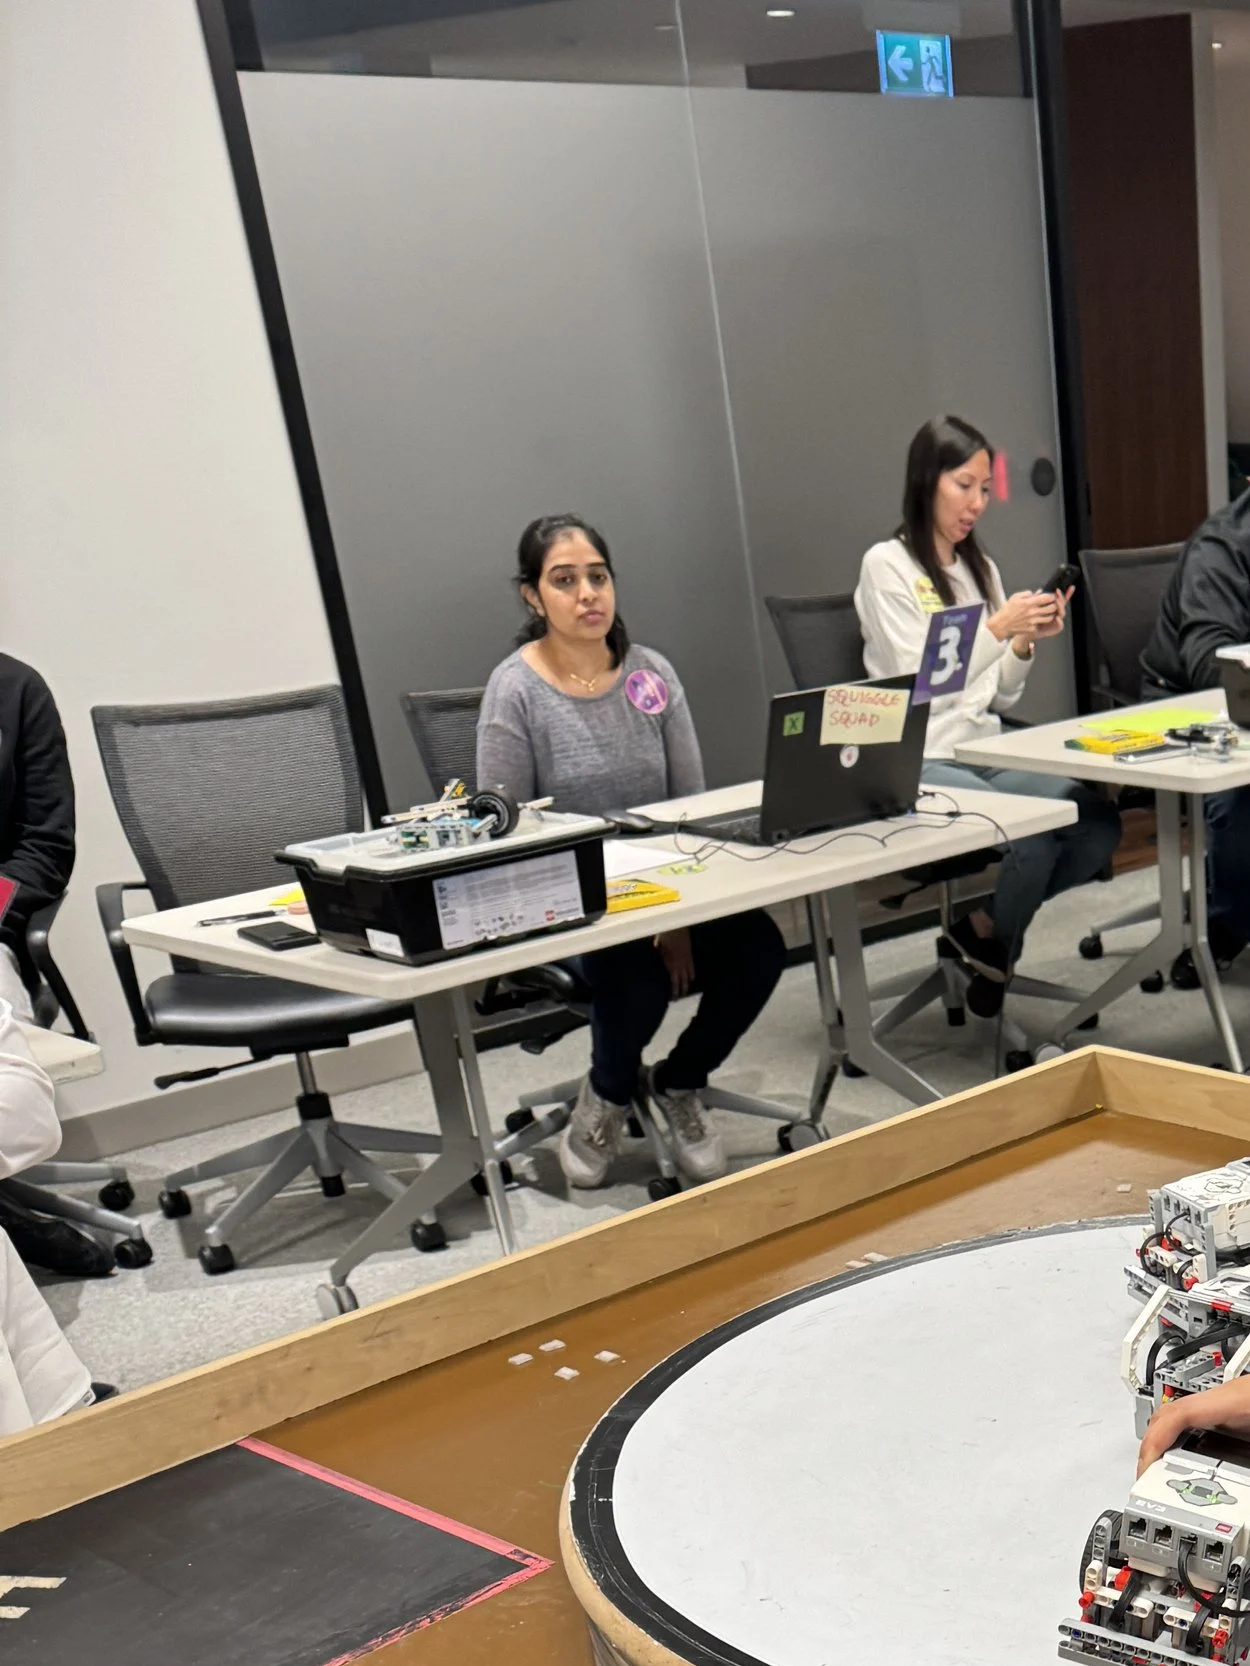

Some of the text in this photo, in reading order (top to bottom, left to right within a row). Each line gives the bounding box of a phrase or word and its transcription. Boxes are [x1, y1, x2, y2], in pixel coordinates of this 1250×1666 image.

[930, 625, 962, 686] 3
[827, 688, 901, 707] SQUIGGLE
[828, 710, 881, 728] SQUAD
